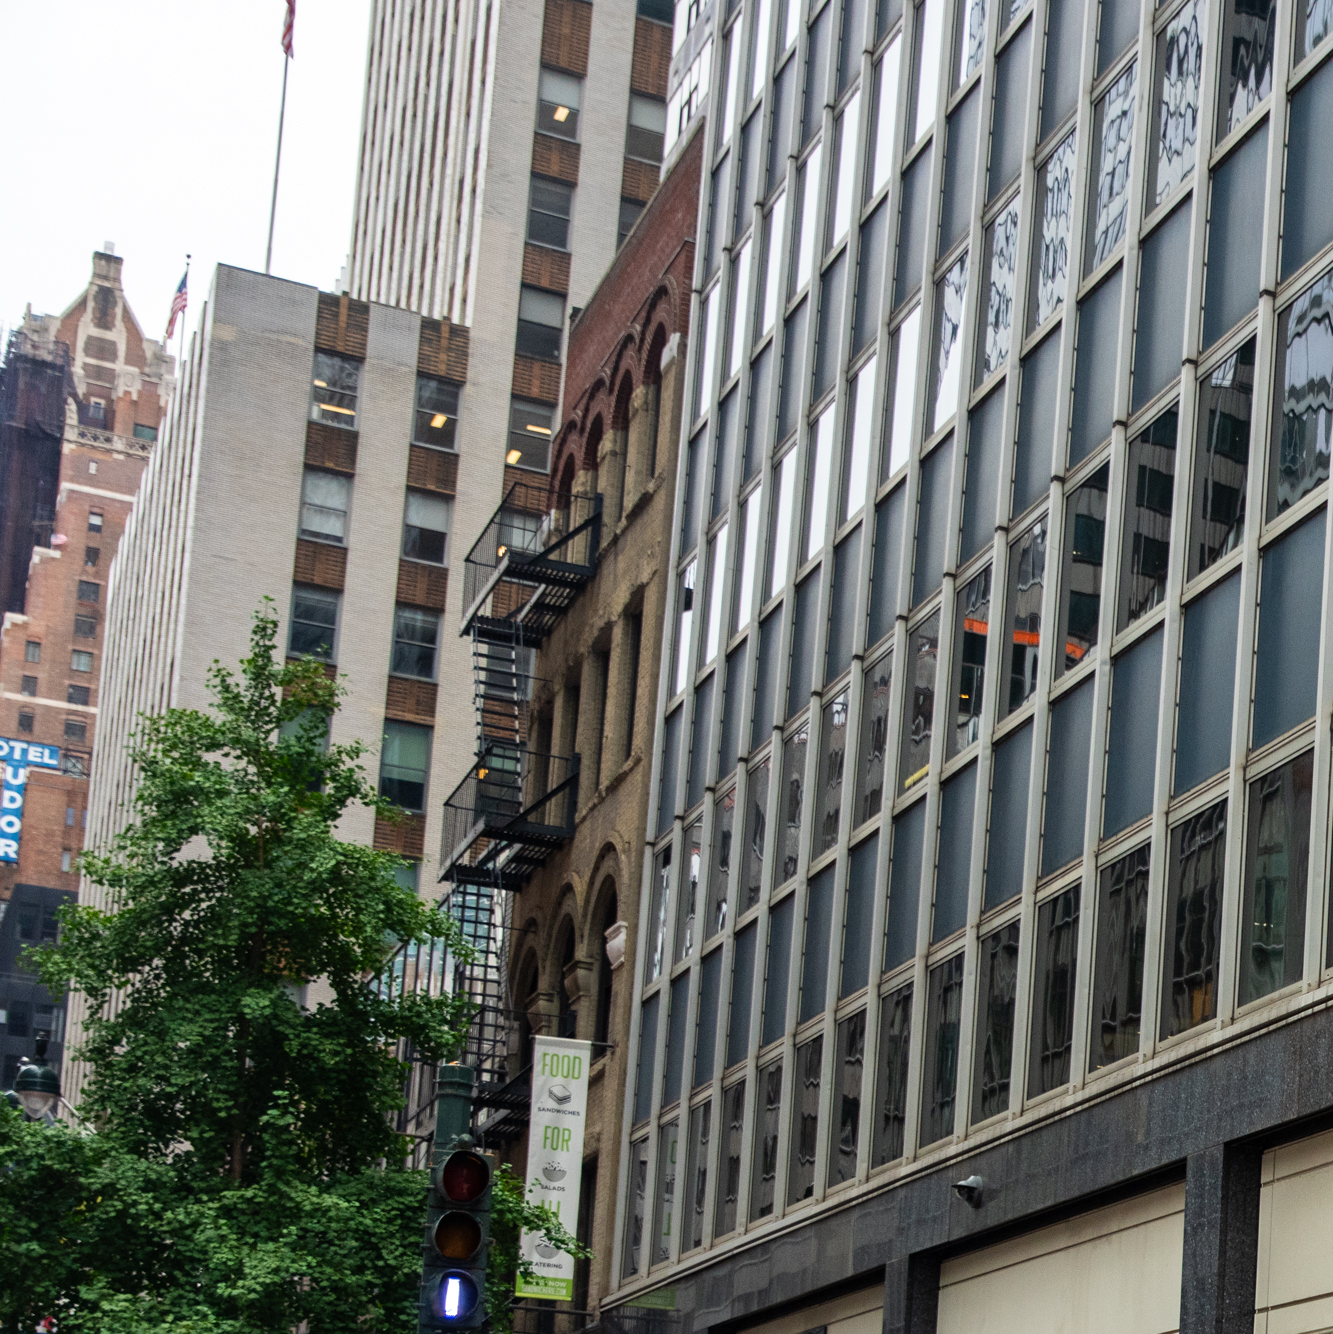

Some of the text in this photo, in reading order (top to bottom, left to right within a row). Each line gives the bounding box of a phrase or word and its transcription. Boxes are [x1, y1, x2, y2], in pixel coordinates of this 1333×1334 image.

[0, 740, 58, 764] OTEL
[542, 1052, 582, 1079] FOOD
[538, 1107, 580, 1116] SANDWICHES
[543, 1126, 571, 1152] FOR
